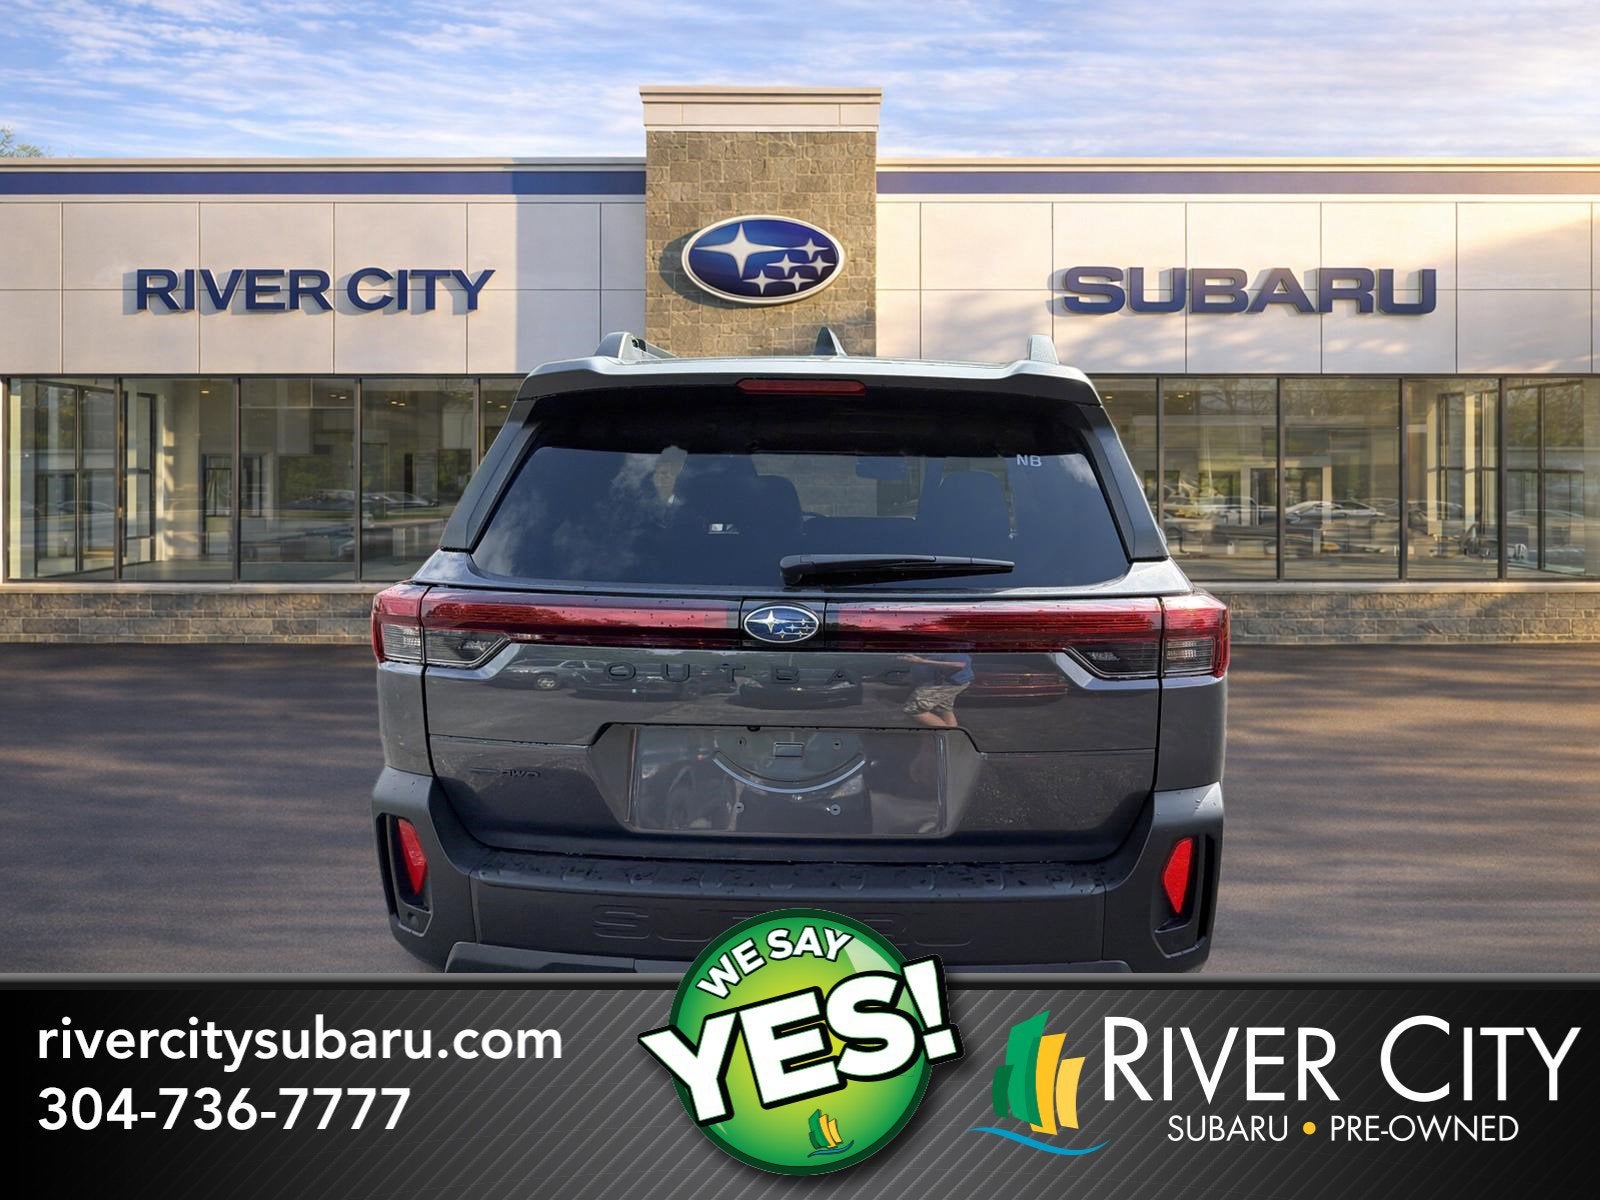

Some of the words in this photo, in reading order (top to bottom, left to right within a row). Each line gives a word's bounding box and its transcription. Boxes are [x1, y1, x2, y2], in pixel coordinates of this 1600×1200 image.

[136, 268, 334, 311] RIVER
[347, 267, 496, 311] CITY
[1062, 266, 1437, 315] SUBARU
[1015, 453, 1042, 468] NB
